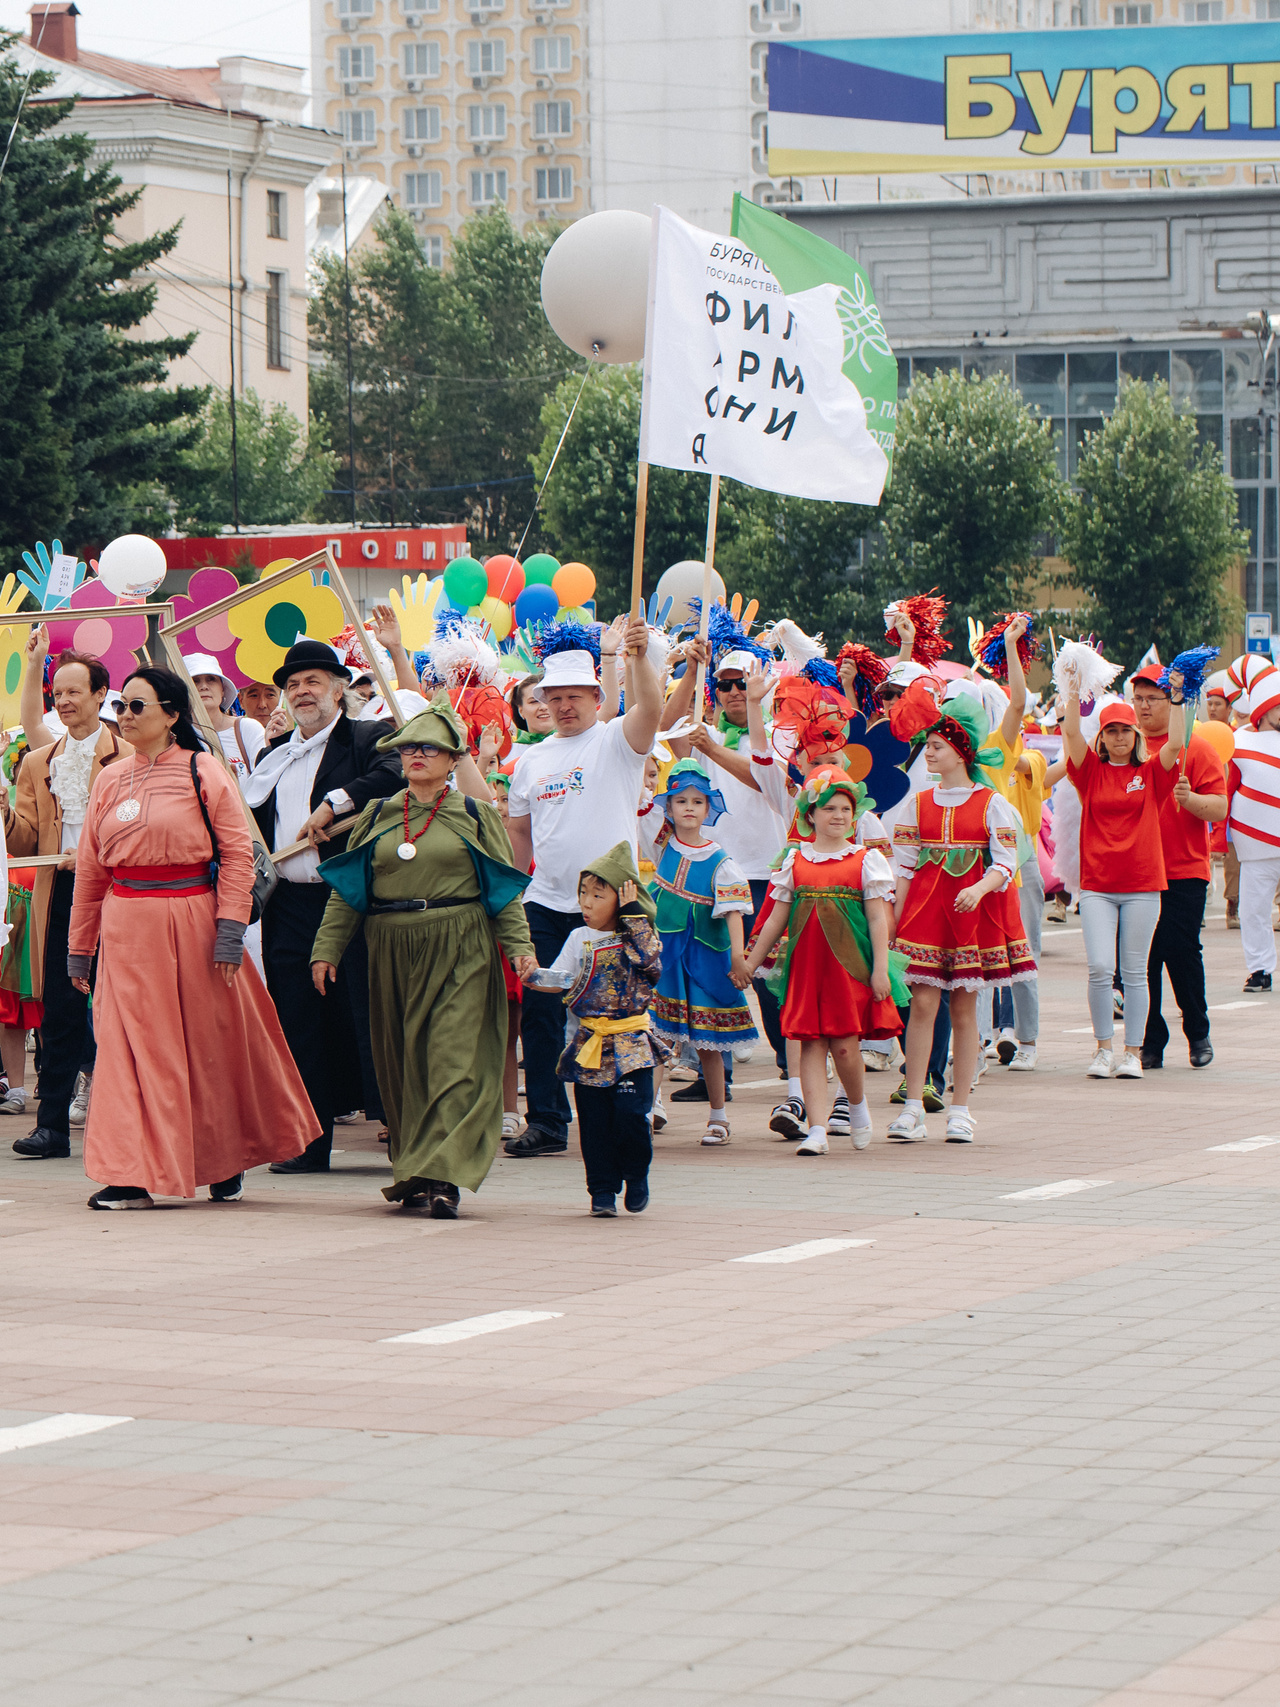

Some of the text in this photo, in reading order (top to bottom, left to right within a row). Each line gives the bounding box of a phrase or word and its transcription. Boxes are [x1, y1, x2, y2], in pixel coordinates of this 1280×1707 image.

[944, 53, 1280, 156] Бурят
[691, 433, 708, 464] Я
[545, 783, 566, 791] ГОЛО
